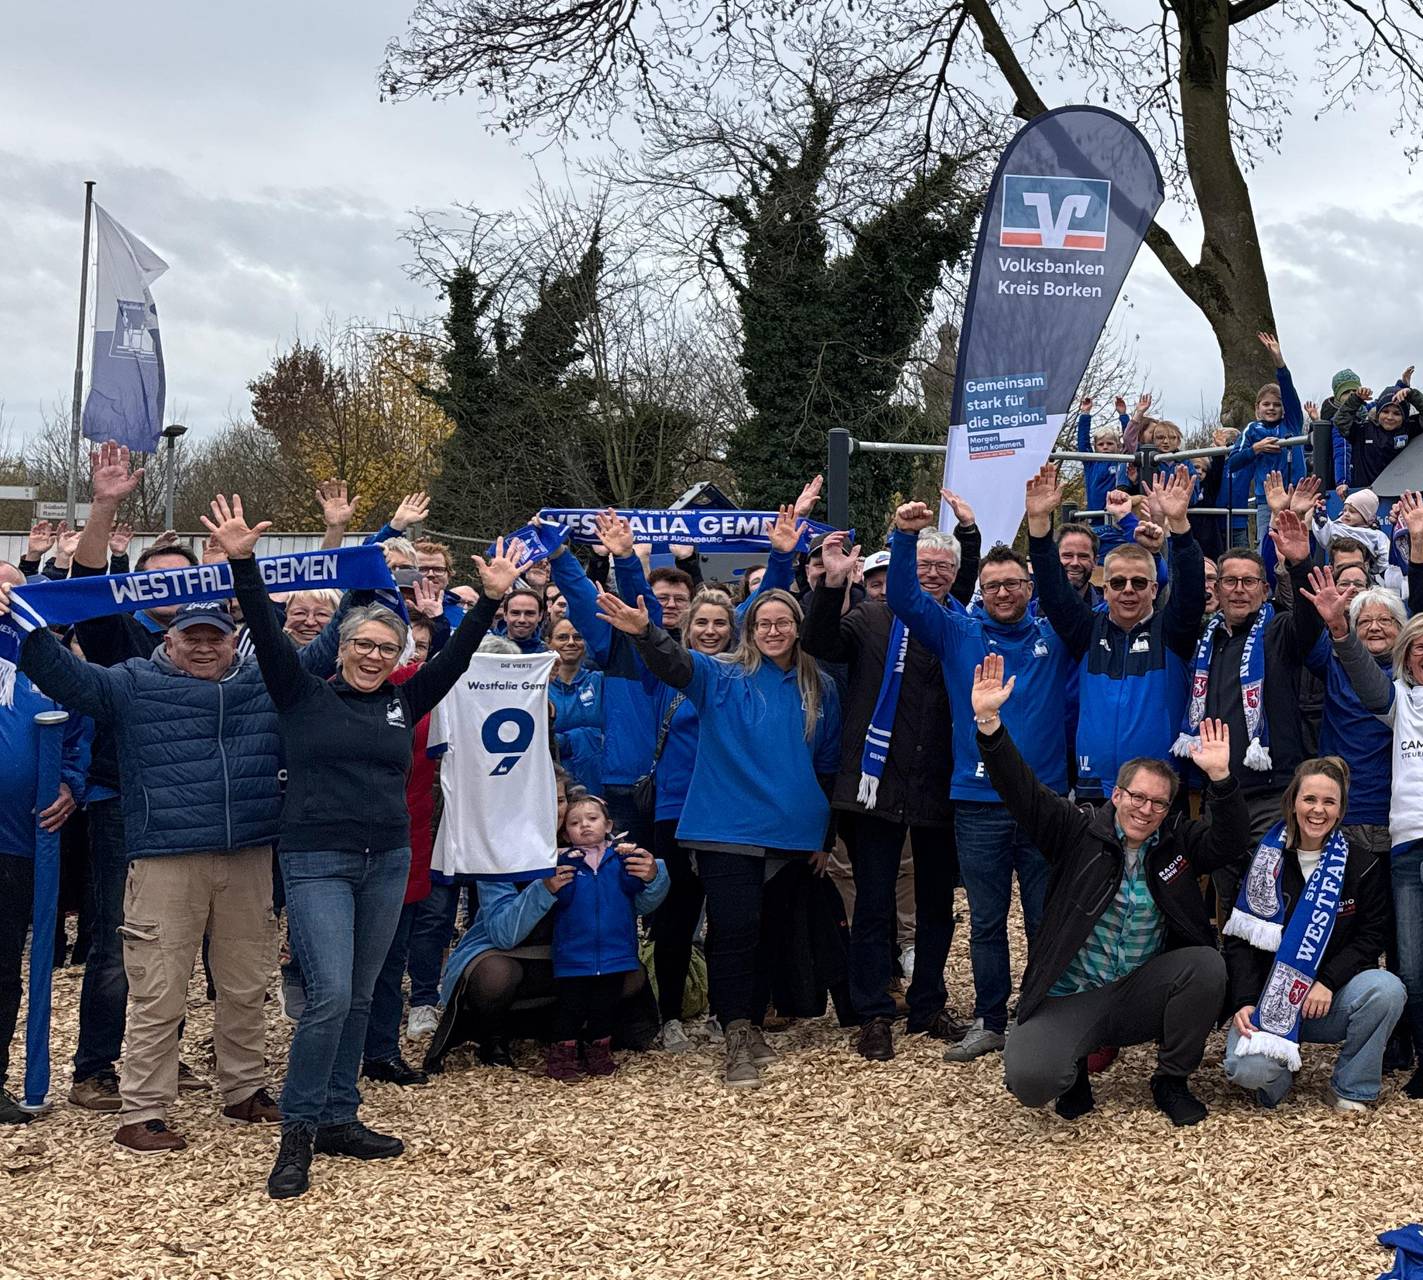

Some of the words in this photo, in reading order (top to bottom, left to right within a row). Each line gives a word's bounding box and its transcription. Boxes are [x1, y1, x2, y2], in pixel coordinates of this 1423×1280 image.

[998, 258, 1105, 275] Volksbanken
[997, 280, 1040, 296] Kreis
[1043, 281, 1102, 297] Borken
[965, 376, 1044, 393] Gemeinsam
[967, 396, 1002, 411] stark
[1004, 394, 1025, 407] für
[968, 416, 990, 429] die
[992, 411, 1044, 427] Region.
[969, 435, 999, 445] Morgen
[698, 516, 776, 536] GEME
[671, 535, 723, 543] JUGENDBURG
[108, 564, 235, 605] WESTFALI
[259, 554, 338, 585] GEMEN
[467, 680, 518, 691] Westfalia
[521, 681, 547, 691] Gem
[481, 707, 535, 776] 9
[1158, 854, 1183, 878] RADIO
[1338, 898, 1355, 907] DIO
